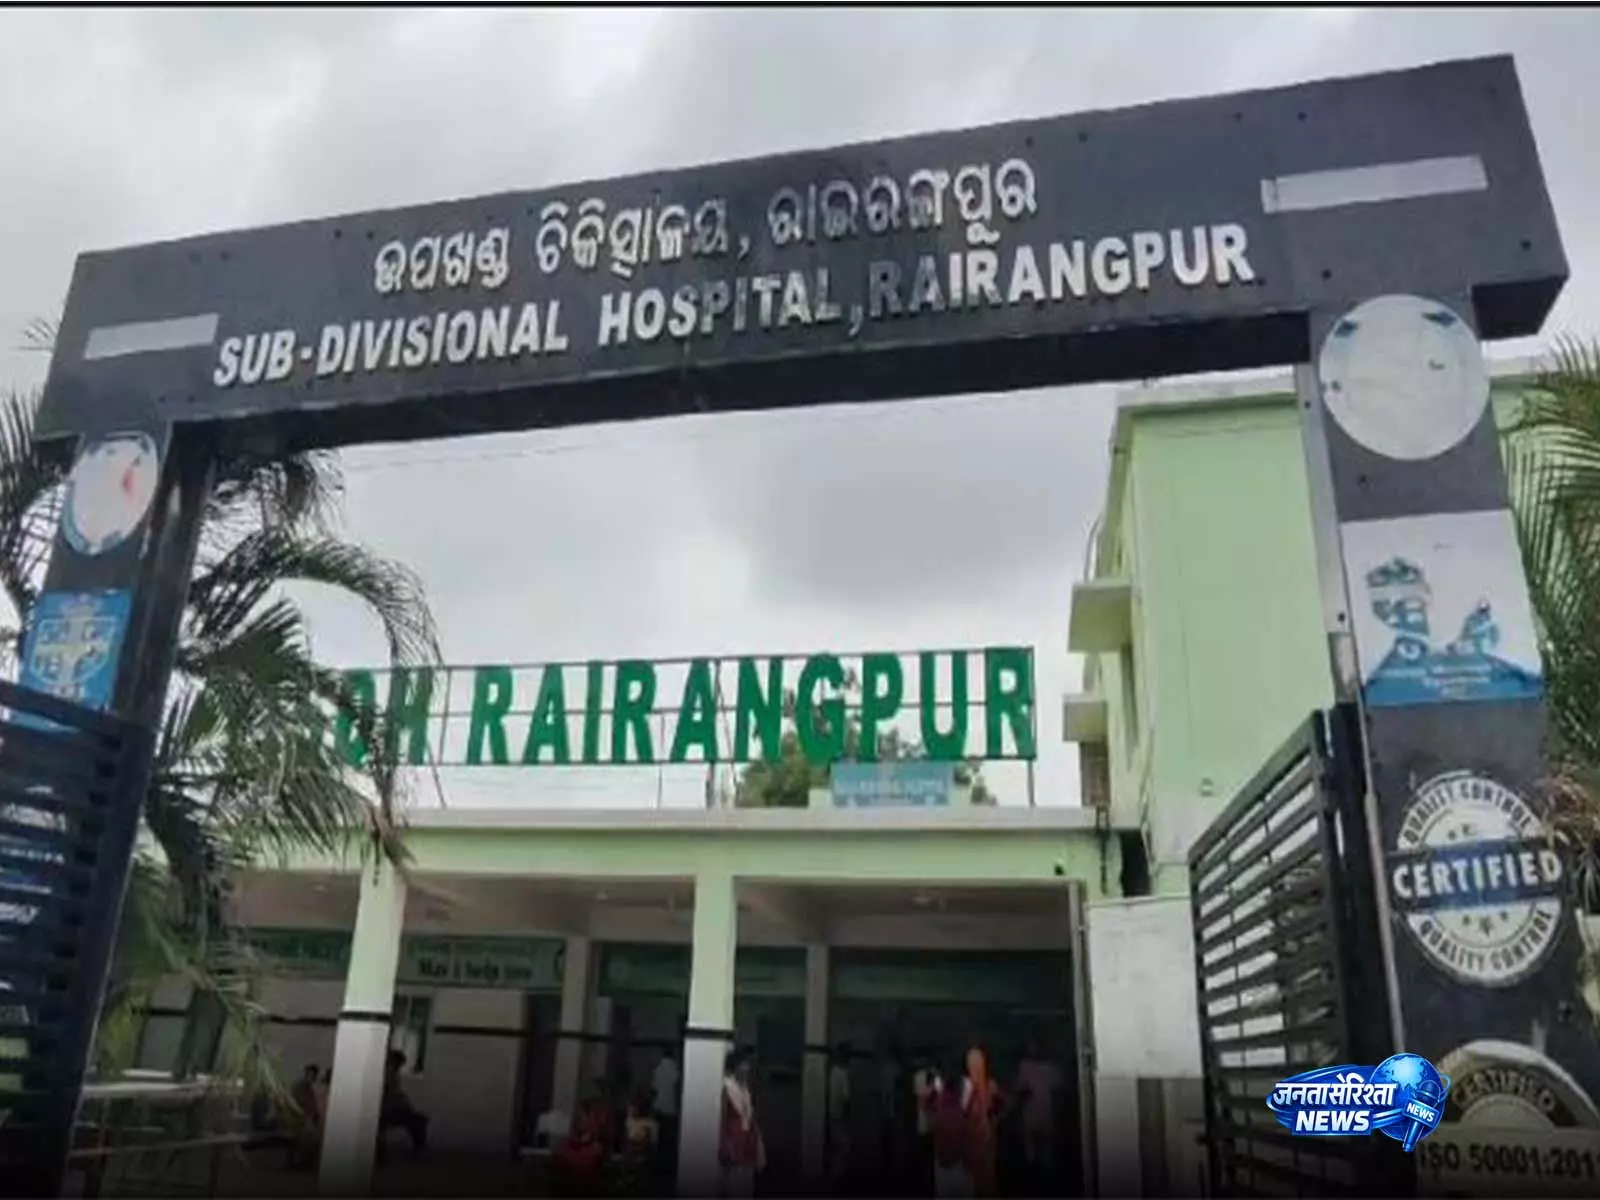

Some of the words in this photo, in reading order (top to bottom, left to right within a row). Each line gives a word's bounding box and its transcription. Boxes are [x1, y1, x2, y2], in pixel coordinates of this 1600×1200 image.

[213, 300, 569, 388] SUB-DIVISIONAL
[466, 647, 1035, 766] RAIRANGPUR
[1392, 850, 1563, 898] CERTIFIED
[1467, 1144, 1600, 1179] 50001:201
